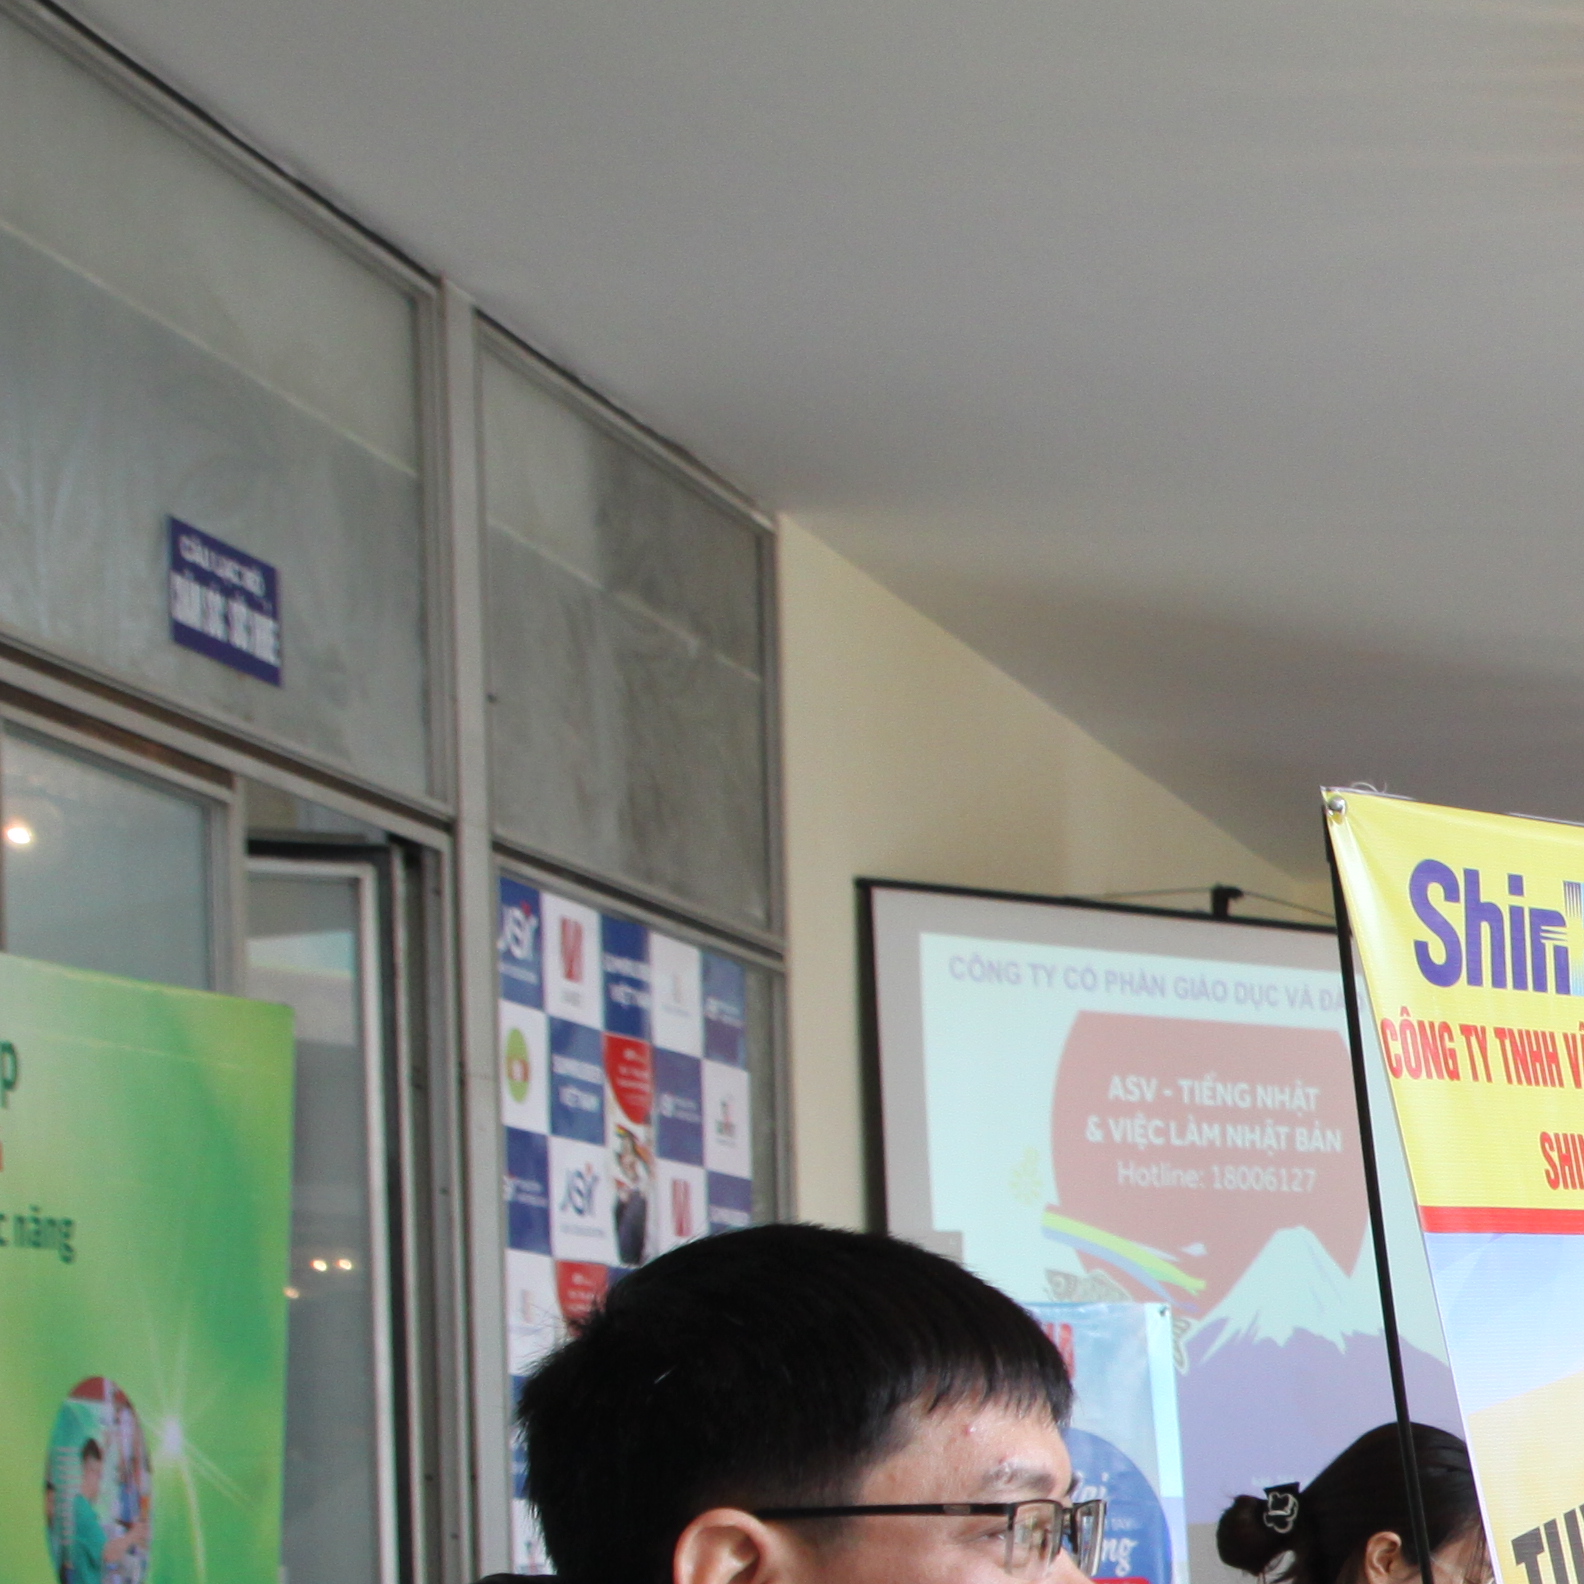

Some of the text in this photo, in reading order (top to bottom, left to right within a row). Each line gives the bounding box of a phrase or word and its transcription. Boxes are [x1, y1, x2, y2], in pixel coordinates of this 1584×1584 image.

[1028, 962, 1059, 989] TY
[1380, 1006, 1461, 1081] CÔNG
[1459, 1023, 1492, 1083] TY
[1494, 1026, 1564, 1088] TNHH
[1108, 1074, 1158, 1102] ASV
[1177, 1071, 1251, 1108] TIẾNG
[1255, 1079, 1319, 1118] NHẬT
[1108, 1113, 1165, 1150] VIỆC
[1169, 1114, 1221, 1147] LÀM
[1225, 1118, 1291, 1156] NHẬT
[1295, 1120, 1344, 1152] BẢN
[1211, 1164, 1317, 1192] 18006127
